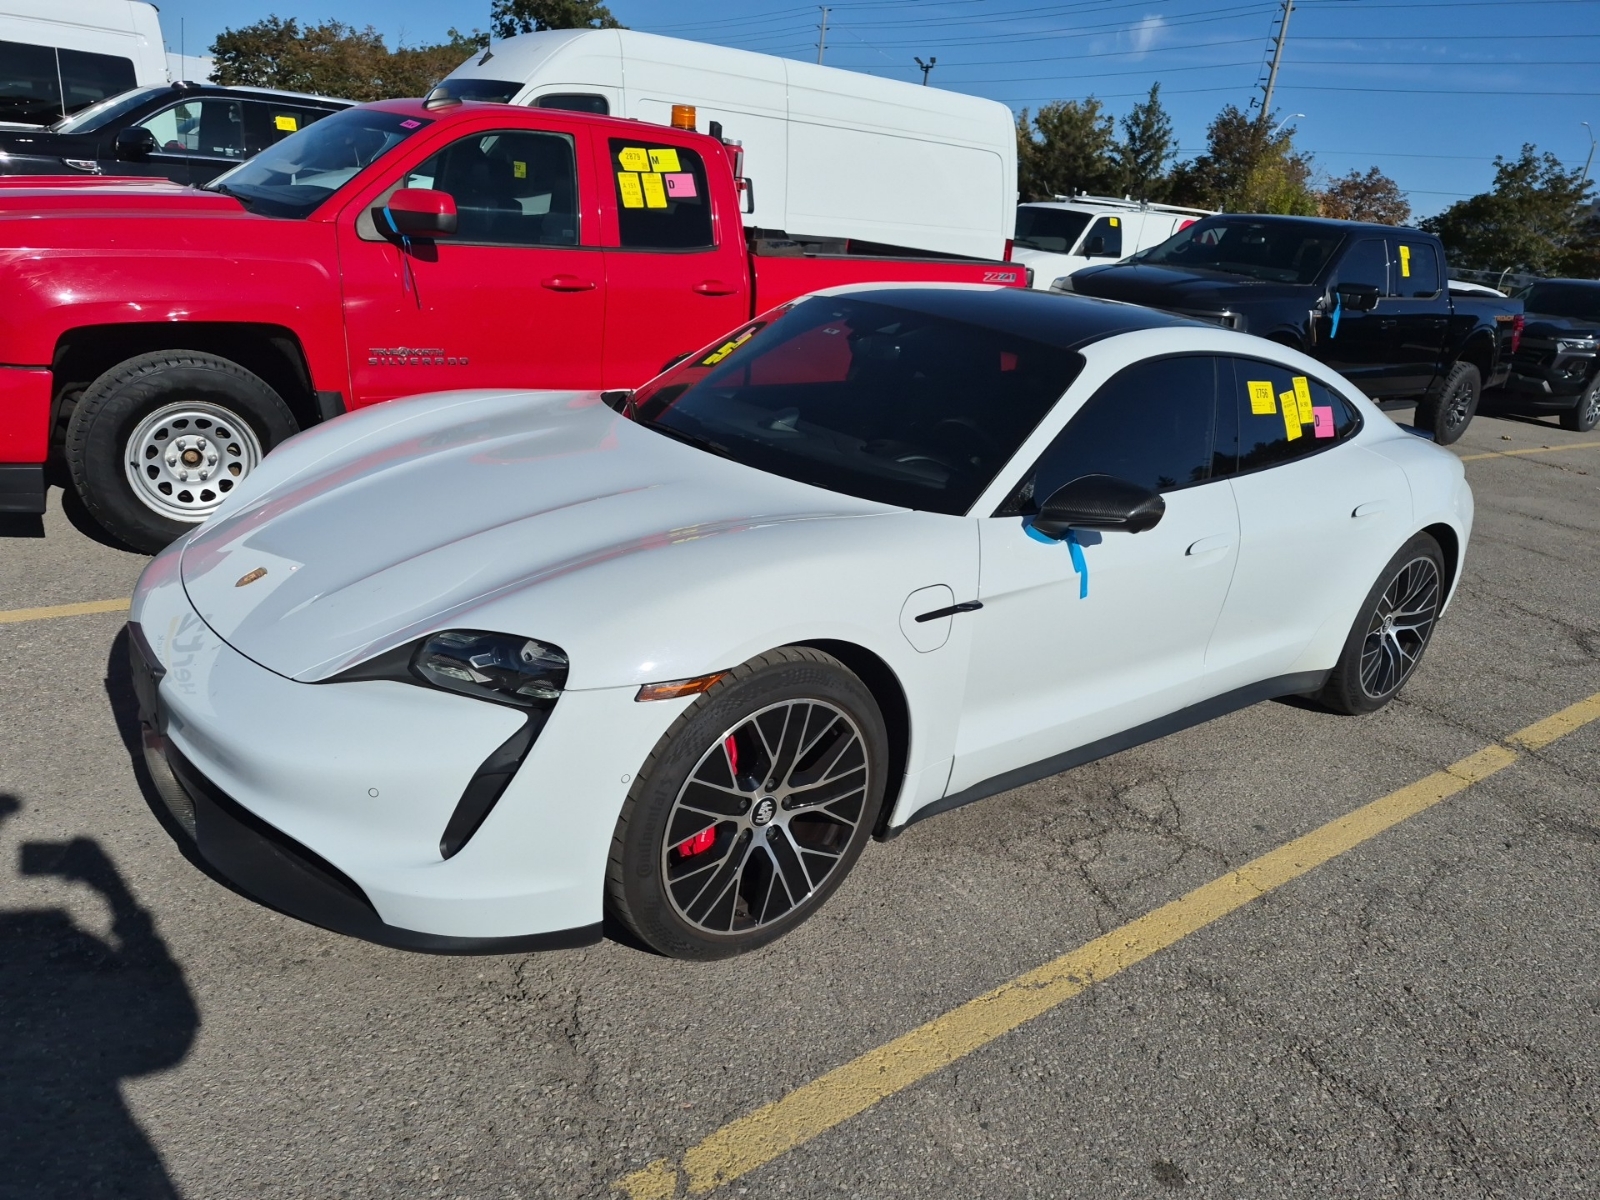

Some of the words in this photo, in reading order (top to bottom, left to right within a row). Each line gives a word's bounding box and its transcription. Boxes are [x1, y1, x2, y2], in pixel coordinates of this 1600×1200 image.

[625, 152, 641, 161] 2879
[651, 155, 660, 165] M
[668, 179, 675, 189] D
[368, 358, 469, 366] SILVERADO
[1255, 388, 1269, 399] 2756
[1315, 414, 1320, 427] D
